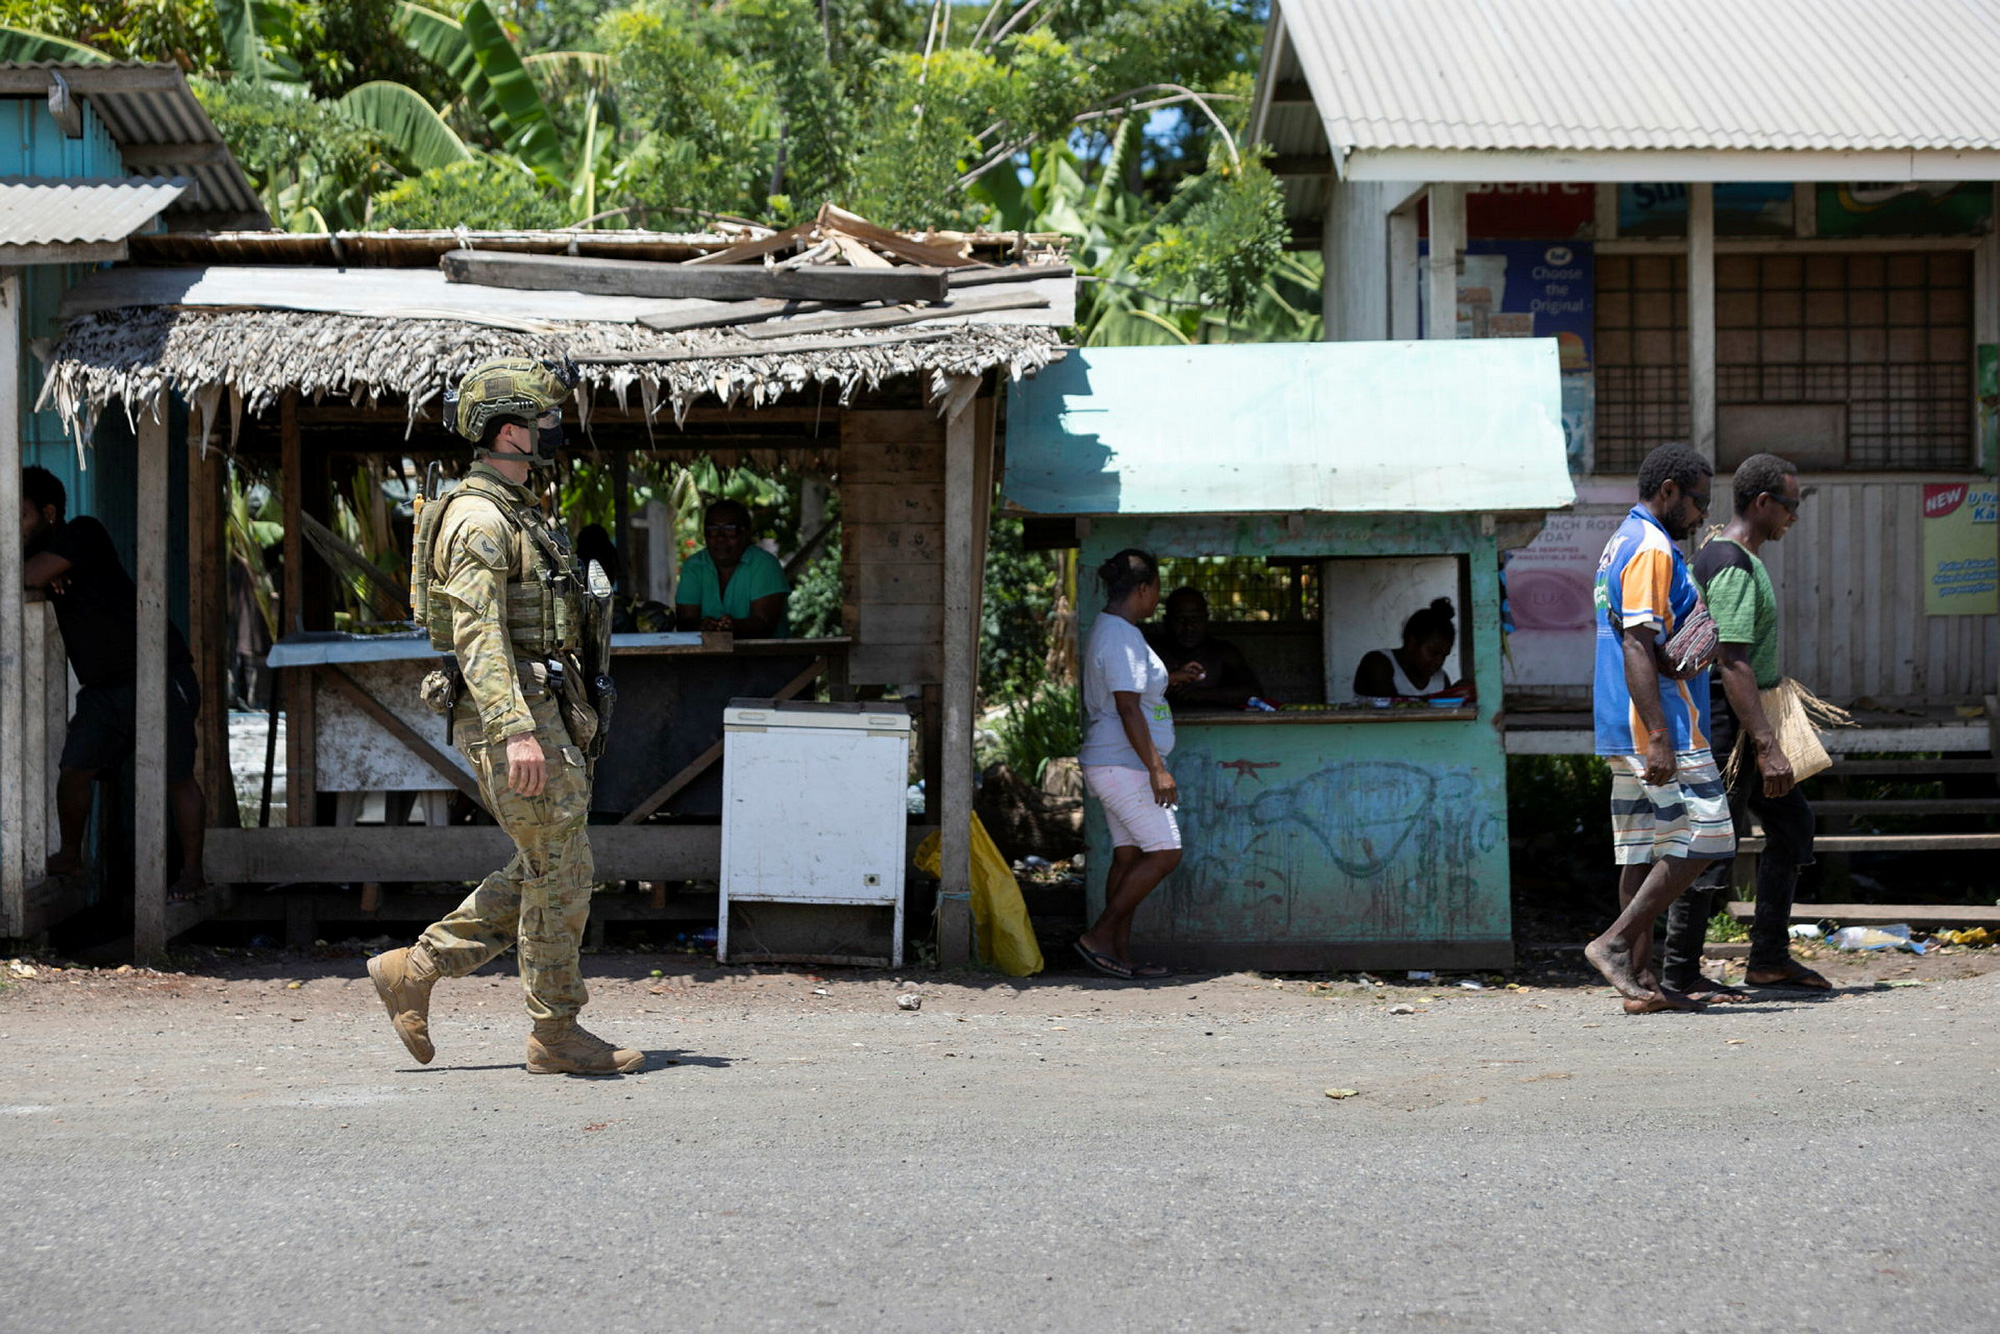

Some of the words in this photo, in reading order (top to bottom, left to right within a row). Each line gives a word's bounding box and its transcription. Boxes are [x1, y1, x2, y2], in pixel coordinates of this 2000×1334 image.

[1532, 265, 1583, 280] Choose
[1546, 282, 1569, 296] the
[1530, 298, 1584, 315] Original
[1926, 486, 1963, 512] NEW
